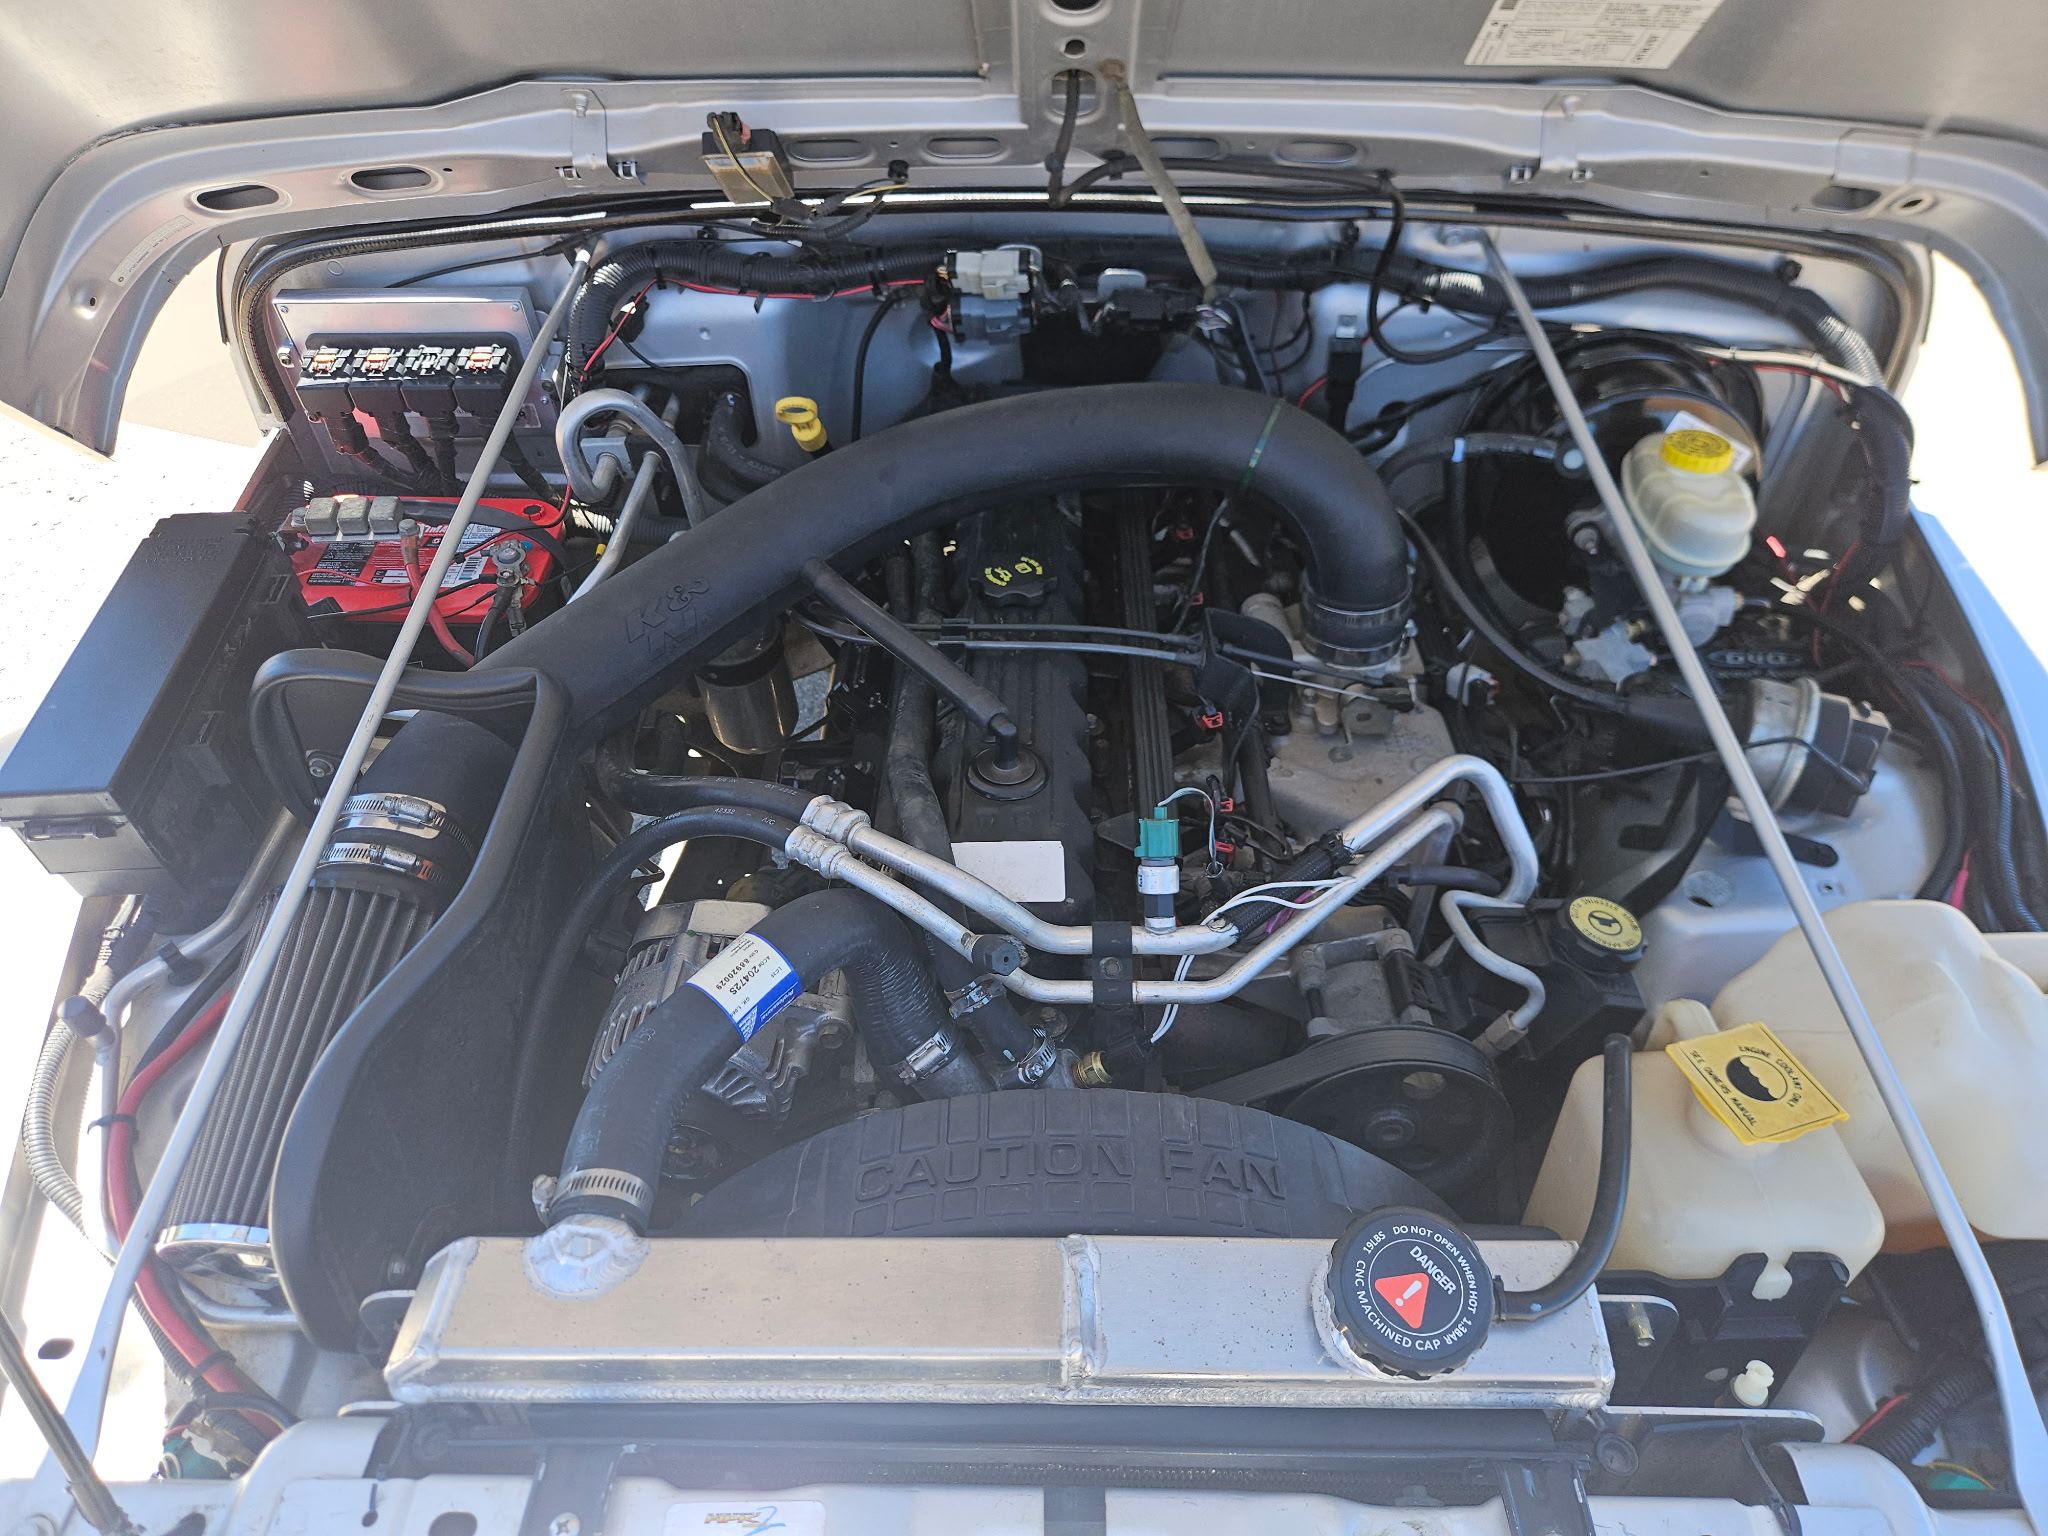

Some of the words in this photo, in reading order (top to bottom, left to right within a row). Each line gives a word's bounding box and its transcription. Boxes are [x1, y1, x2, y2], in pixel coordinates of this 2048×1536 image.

[729, 965, 760, 995] 20472S
[1689, 1049, 1706, 1064] SEE
[1731, 1097, 1759, 1127] MANUAL
[1737, 1044, 1772, 1059] ENGINE
[1775, 1058, 1803, 1092] COOLANT
[853, 1141, 1136, 1201] CAUTION
[1164, 1146, 1286, 1200] FAN
[1363, 1230, 1386, 1255] 19LBS
[1354, 1260, 1366, 1287] CNC
[1392, 1225, 1409, 1235] DO
[1410, 1225, 1433, 1238] NOT
[1433, 1233, 1458, 1257] OPEN
[1457, 1254, 1477, 1289] WHEN
[1468, 1290, 1479, 1314] HOT
[1409, 1245, 1457, 1296] DANGER
[1356, 1290, 1412, 1348] MACHINED
[1443, 1316, 1472, 1345] 1.3BAR
[1415, 1339, 1441, 1351] CAP
